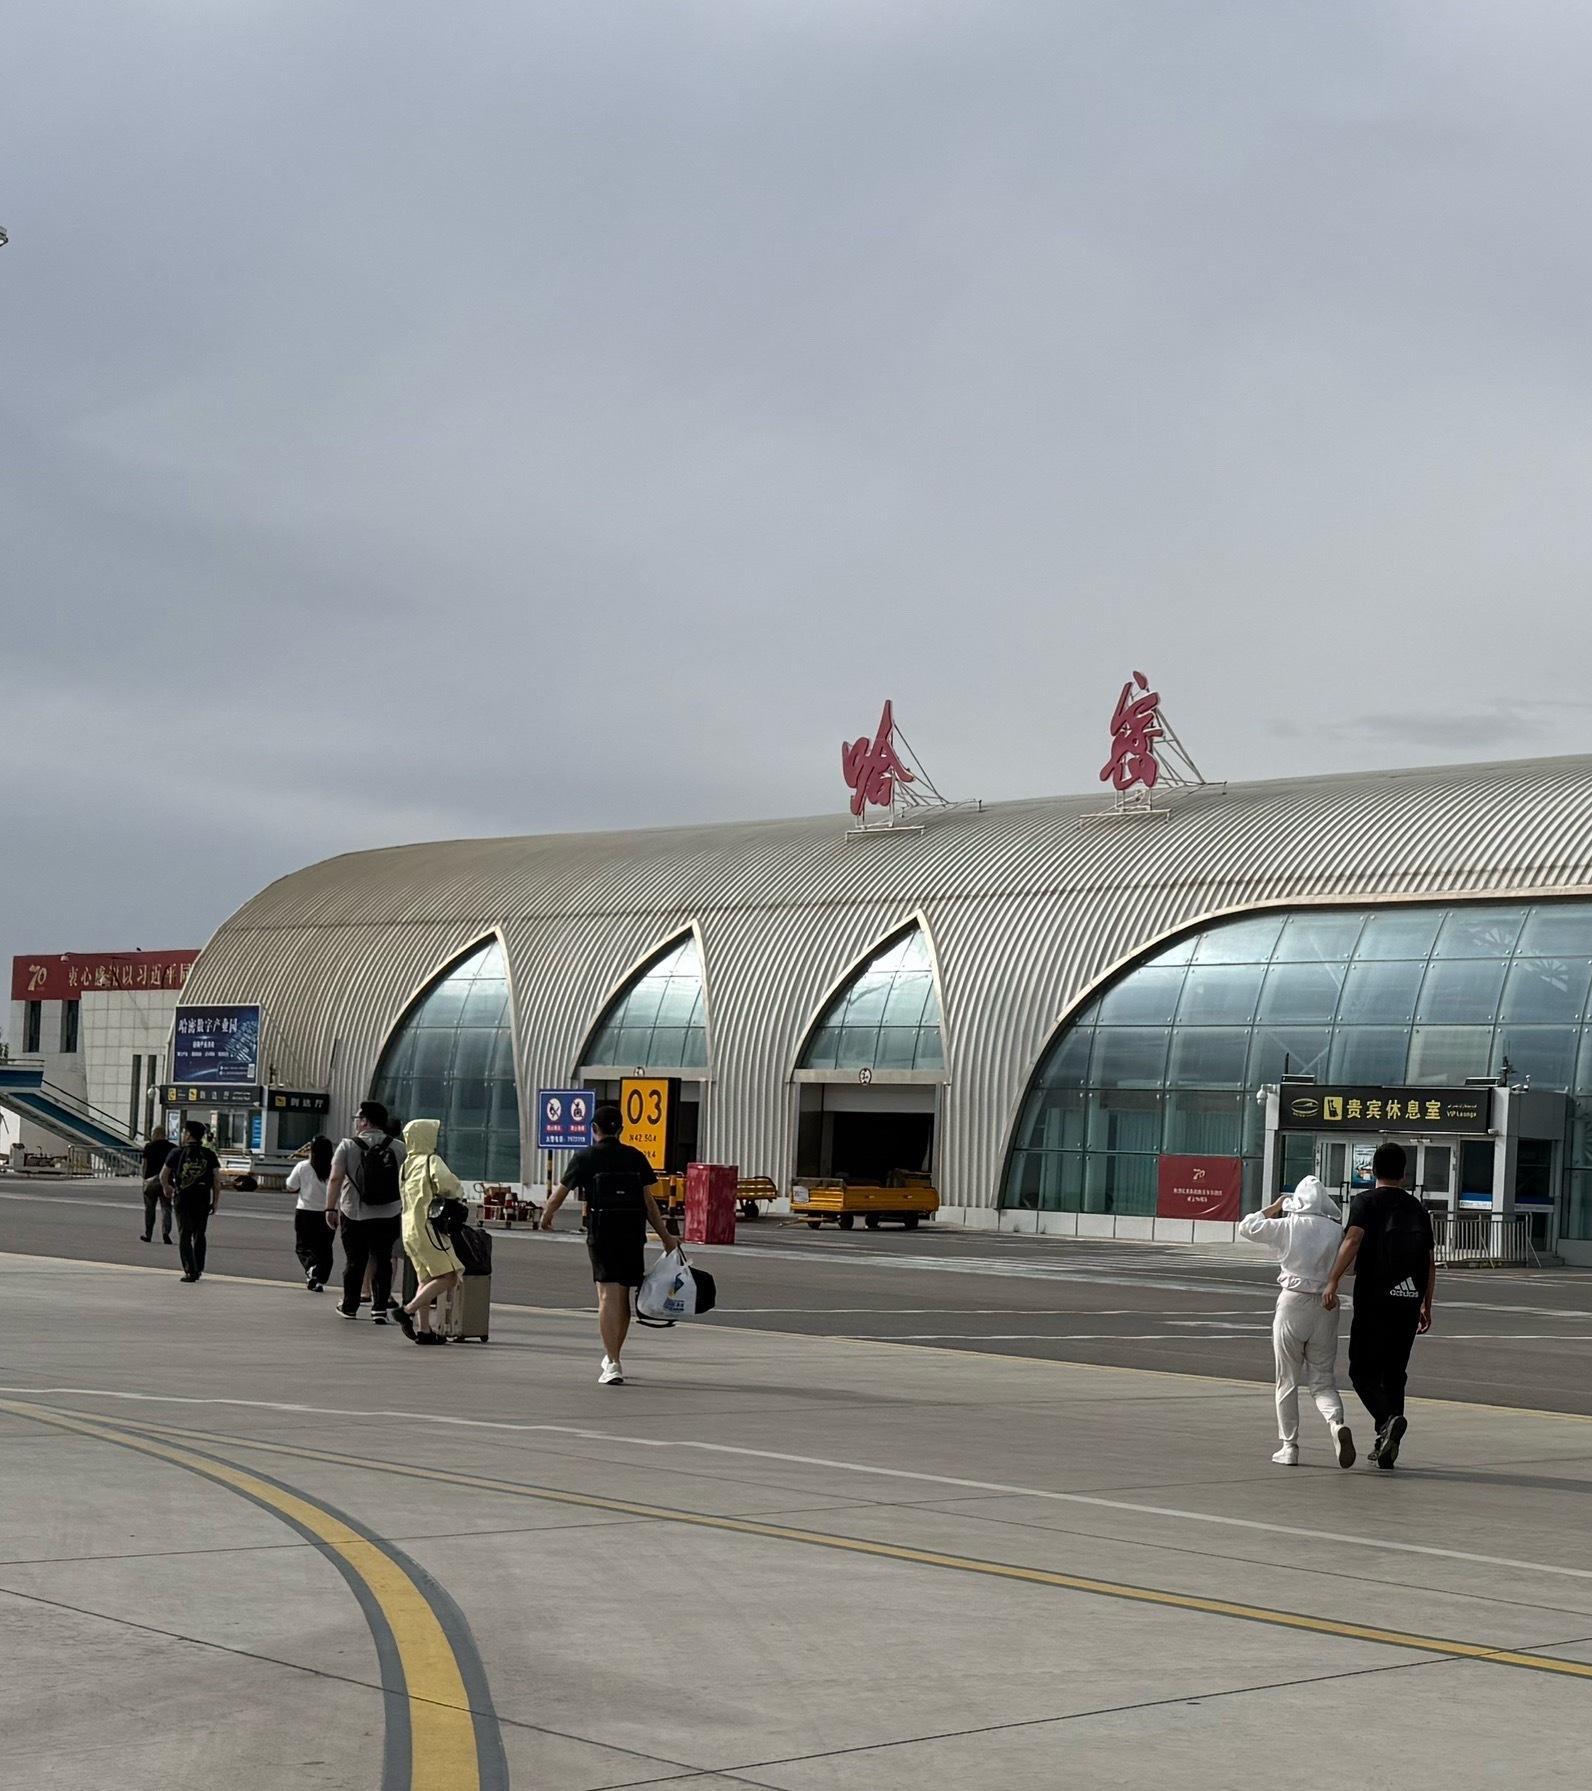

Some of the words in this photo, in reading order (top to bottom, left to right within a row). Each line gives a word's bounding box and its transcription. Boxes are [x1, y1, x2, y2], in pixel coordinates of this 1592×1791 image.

[28, 965, 47, 991] 70
[178, 1017, 238, 1034] 哈密数字产业园
[627, 1089, 662, 1125] 03
[1346, 1099, 1441, 1120] 贵宾休息室
[1193, 1168, 1206, 1180] 70
[1390, 1289, 1419, 1298] adidas
